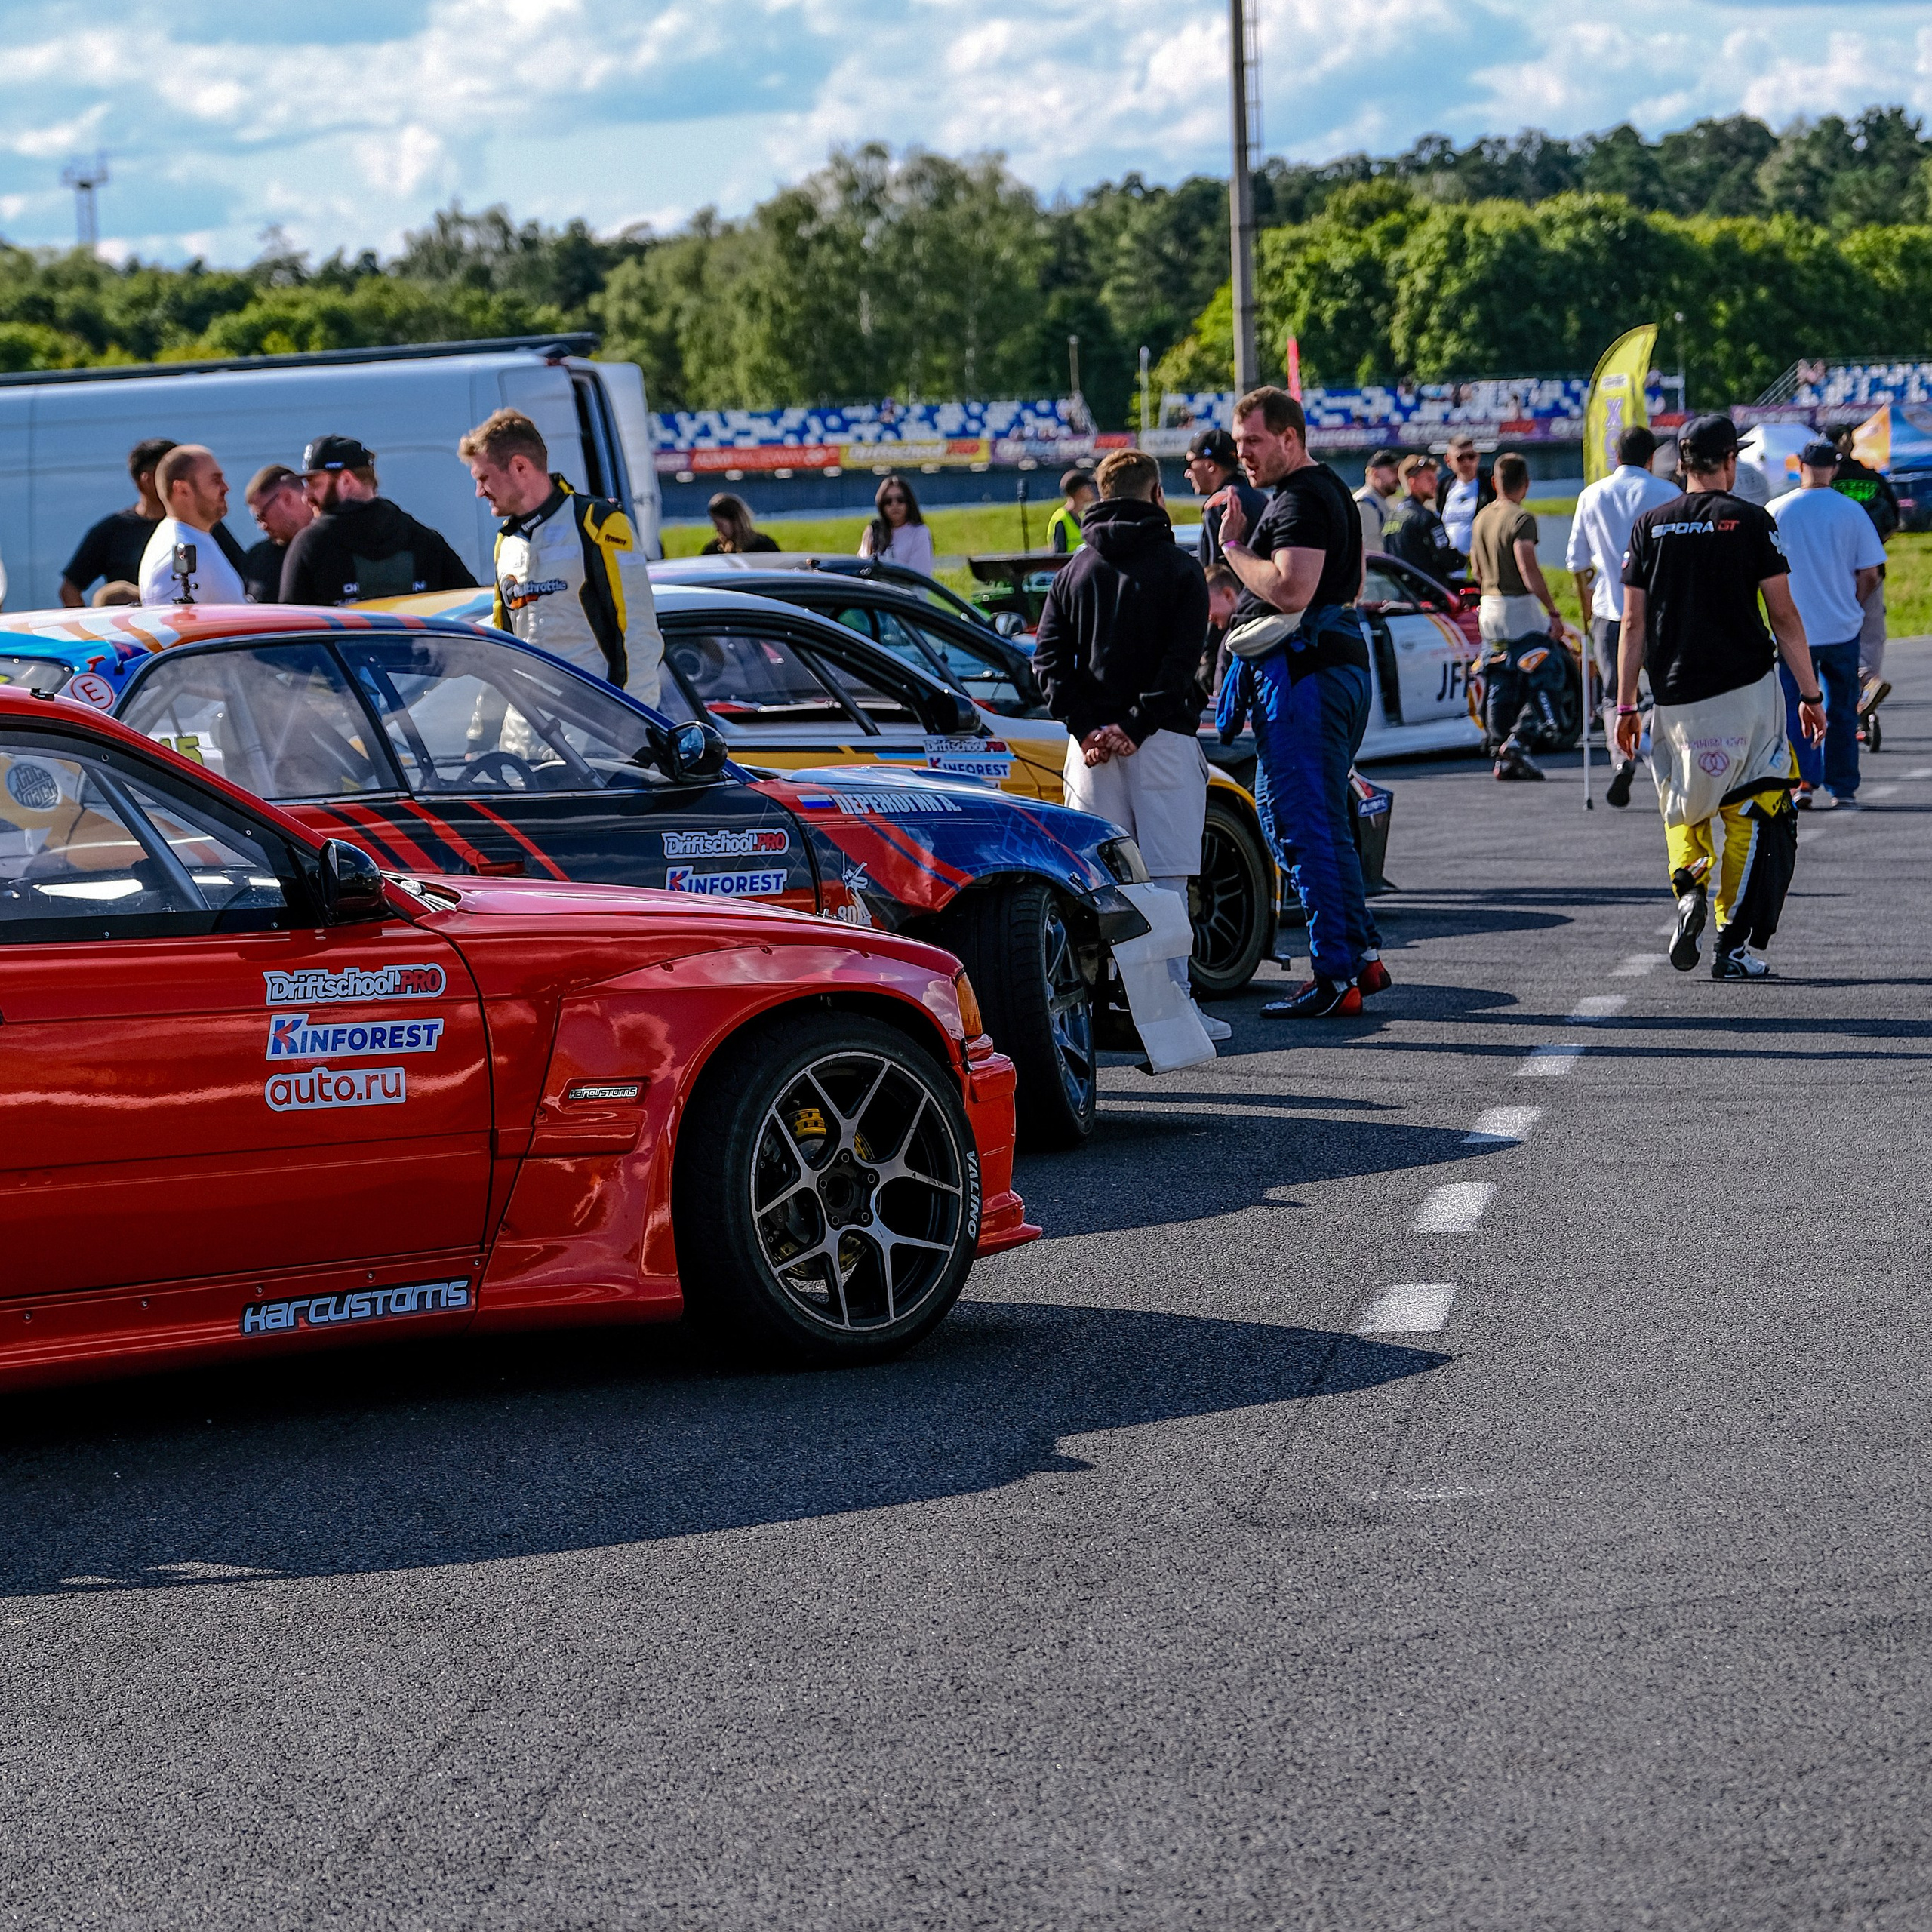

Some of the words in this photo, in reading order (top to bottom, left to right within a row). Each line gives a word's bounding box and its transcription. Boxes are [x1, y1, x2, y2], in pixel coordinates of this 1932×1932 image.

[831, 794, 941, 814] ПЕРЕЖОГИН
[669, 869, 783, 894] KINFOREST
[271, 1019, 439, 1055] KINFOREST
[269, 1072, 401, 1106] auto.ru
[967, 1150, 980, 1240] VALINO
